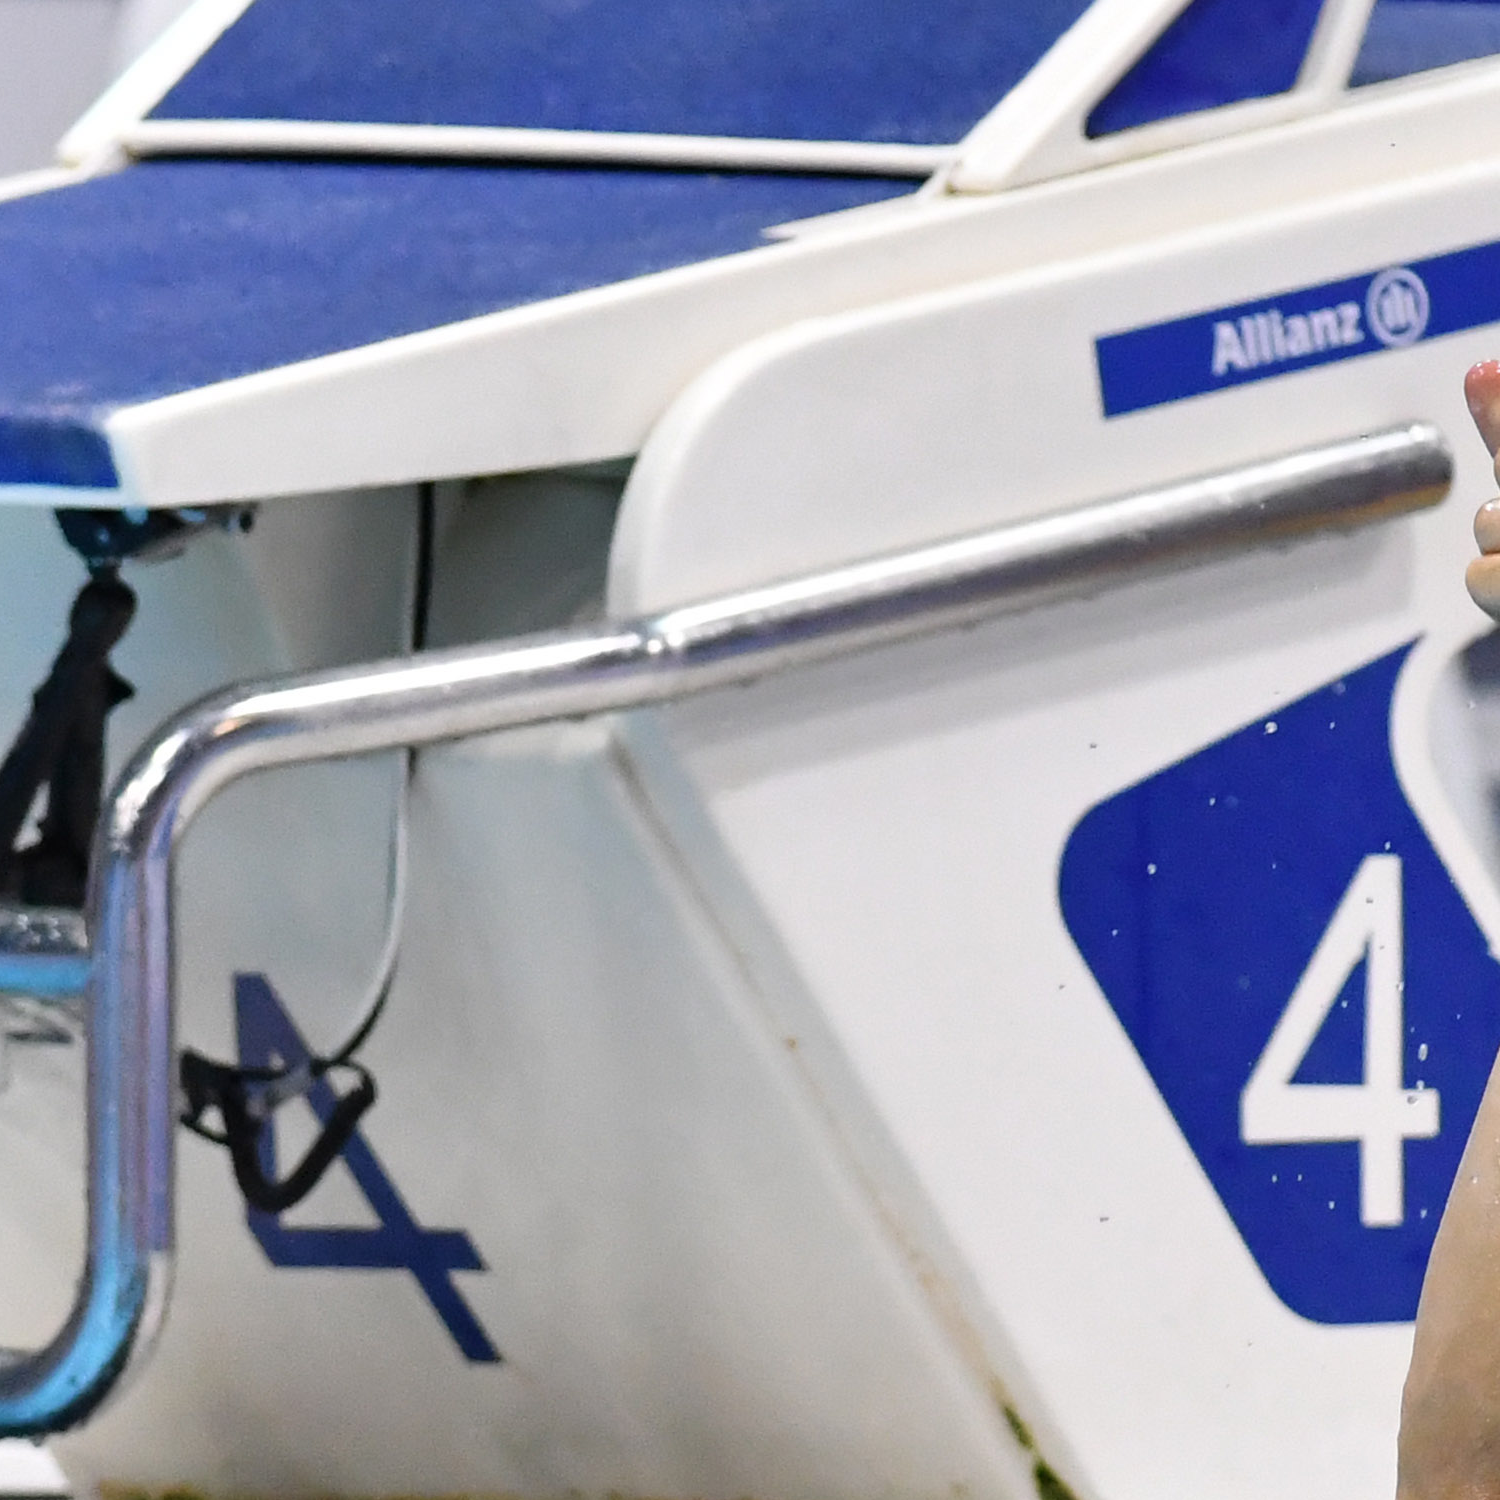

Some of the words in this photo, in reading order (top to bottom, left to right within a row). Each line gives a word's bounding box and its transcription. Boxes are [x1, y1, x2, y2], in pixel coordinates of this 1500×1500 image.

[1211, 300, 1366, 377] Allianz
[234, 970, 503, 1363] 4
[1240, 853, 1441, 1227] 4
